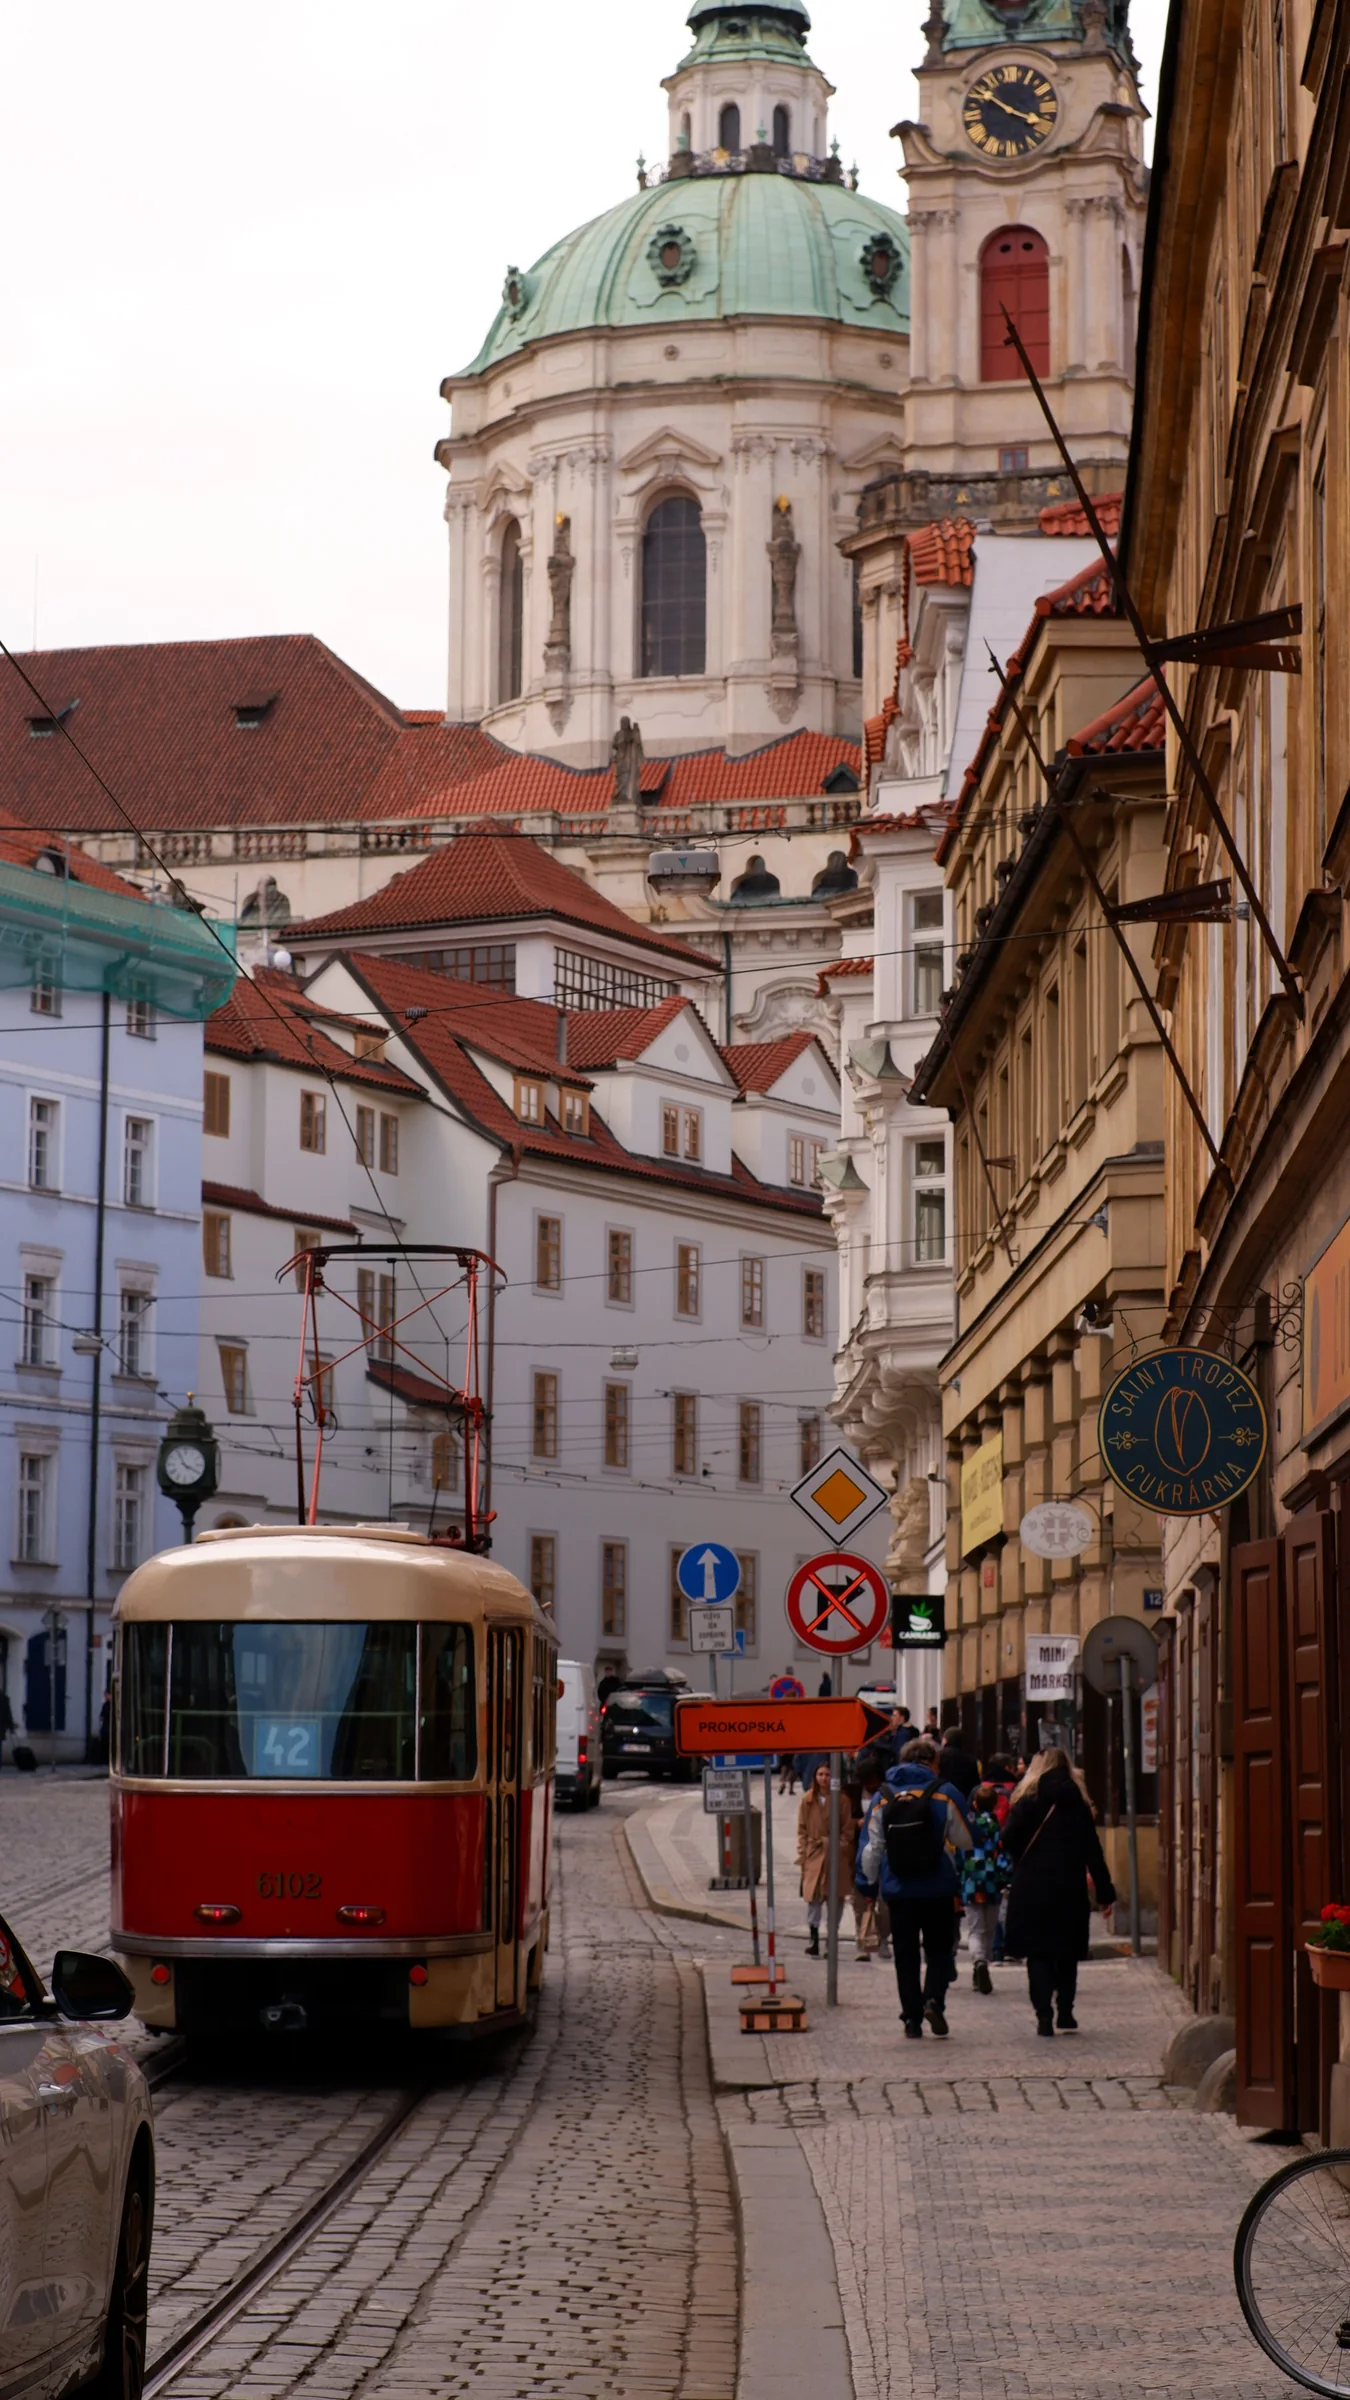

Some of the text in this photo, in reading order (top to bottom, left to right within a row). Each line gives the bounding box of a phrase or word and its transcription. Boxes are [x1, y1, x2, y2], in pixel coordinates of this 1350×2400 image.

[1111, 1356, 1254, 1417] SAINT TROPEZ
[1126, 1462, 1247, 1505] CUKRÁRNA
[1149, 1593, 1162, 1605] 12
[1039, 1646, 1066, 1662] MINI
[1030, 1673, 1073, 1689] MARKET
[699, 1720, 786, 1733] PROKOPSKÁ
[264, 1726, 310, 1766] 42
[257, 1871, 322, 1899] 6102
